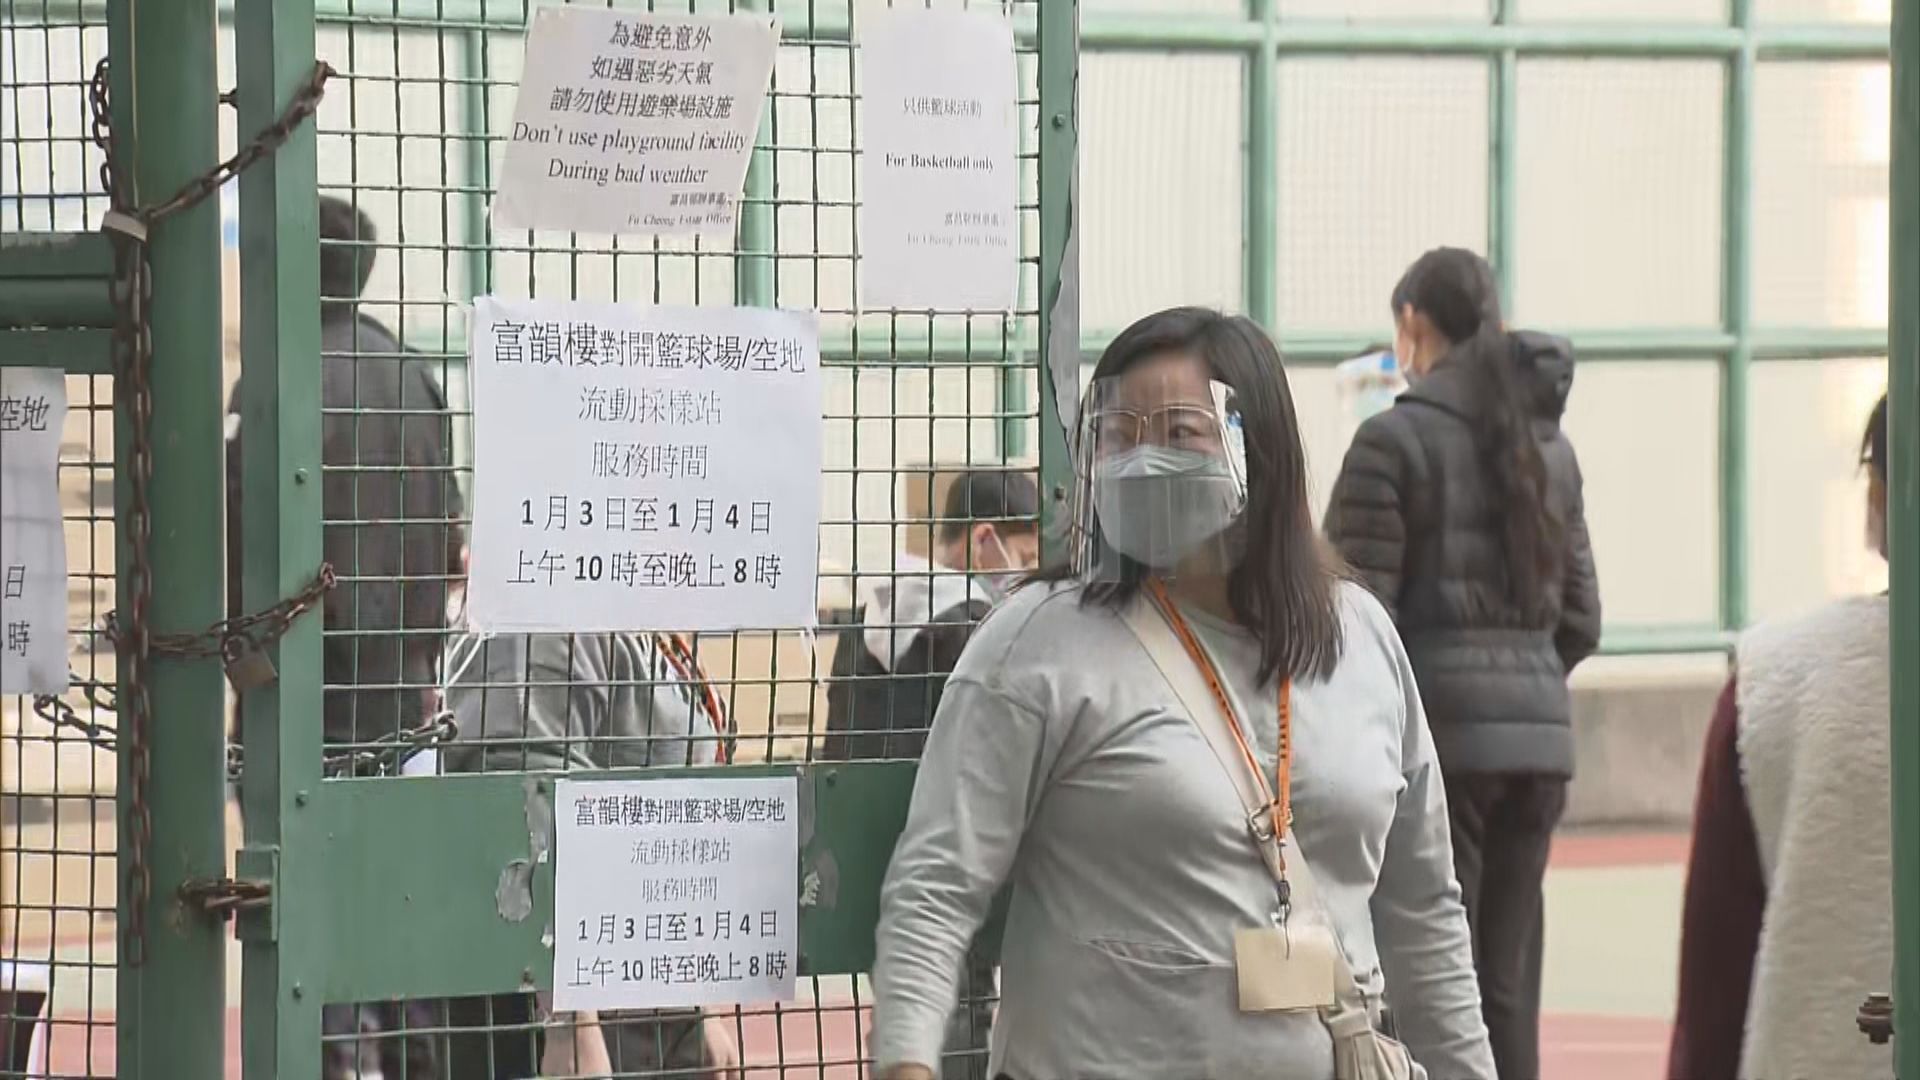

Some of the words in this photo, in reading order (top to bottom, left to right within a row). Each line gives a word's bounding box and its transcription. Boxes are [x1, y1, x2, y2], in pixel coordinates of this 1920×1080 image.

[609, 20, 711, 52] 為避免意外
[590, 55, 714, 86] 如遇惡劣天氣
[550, 86, 734, 119] 請勿使用遊樂場設施
[513, 122, 562, 143] Don't
[569, 131, 598, 147] use
[602, 129, 694, 154] playground
[700, 130, 748, 154] facility
[548, 158, 609, 186] During
[615, 163, 645, 183] bad
[650, 164, 708, 183] weather
[886, 153, 908, 167] For
[911, 153, 970, 169] Basketball
[972, 155, 994, 173] only
[578, 385, 721, 426] 流動採樣站
[592, 441, 709, 480] 服務時間
